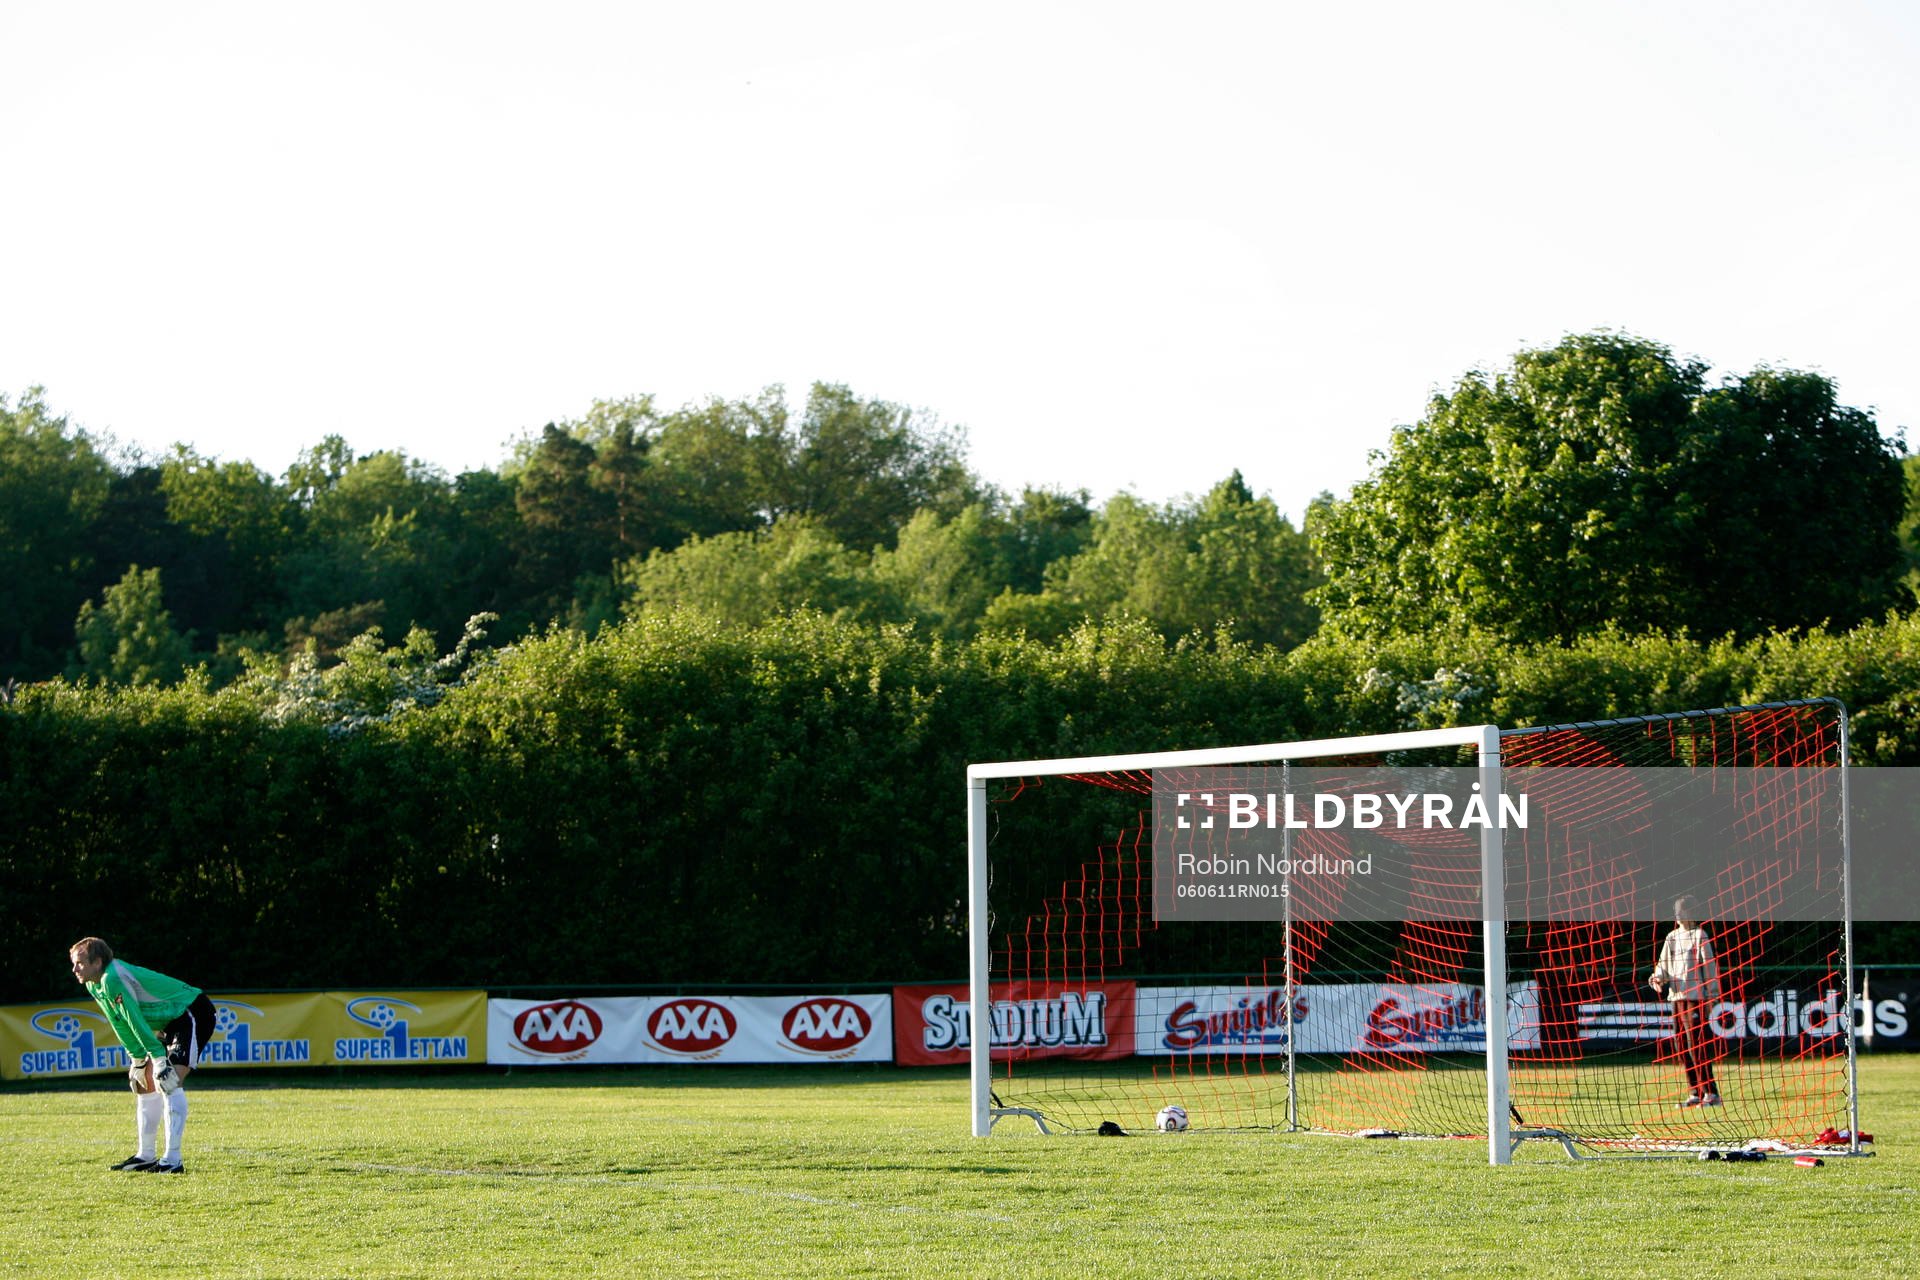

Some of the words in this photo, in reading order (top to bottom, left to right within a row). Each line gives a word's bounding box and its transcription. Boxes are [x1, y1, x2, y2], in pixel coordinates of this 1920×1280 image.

[520, 1006, 596, 1042] AXA
[654, 1005, 730, 1040] AXA
[789, 1004, 864, 1039] AXA
